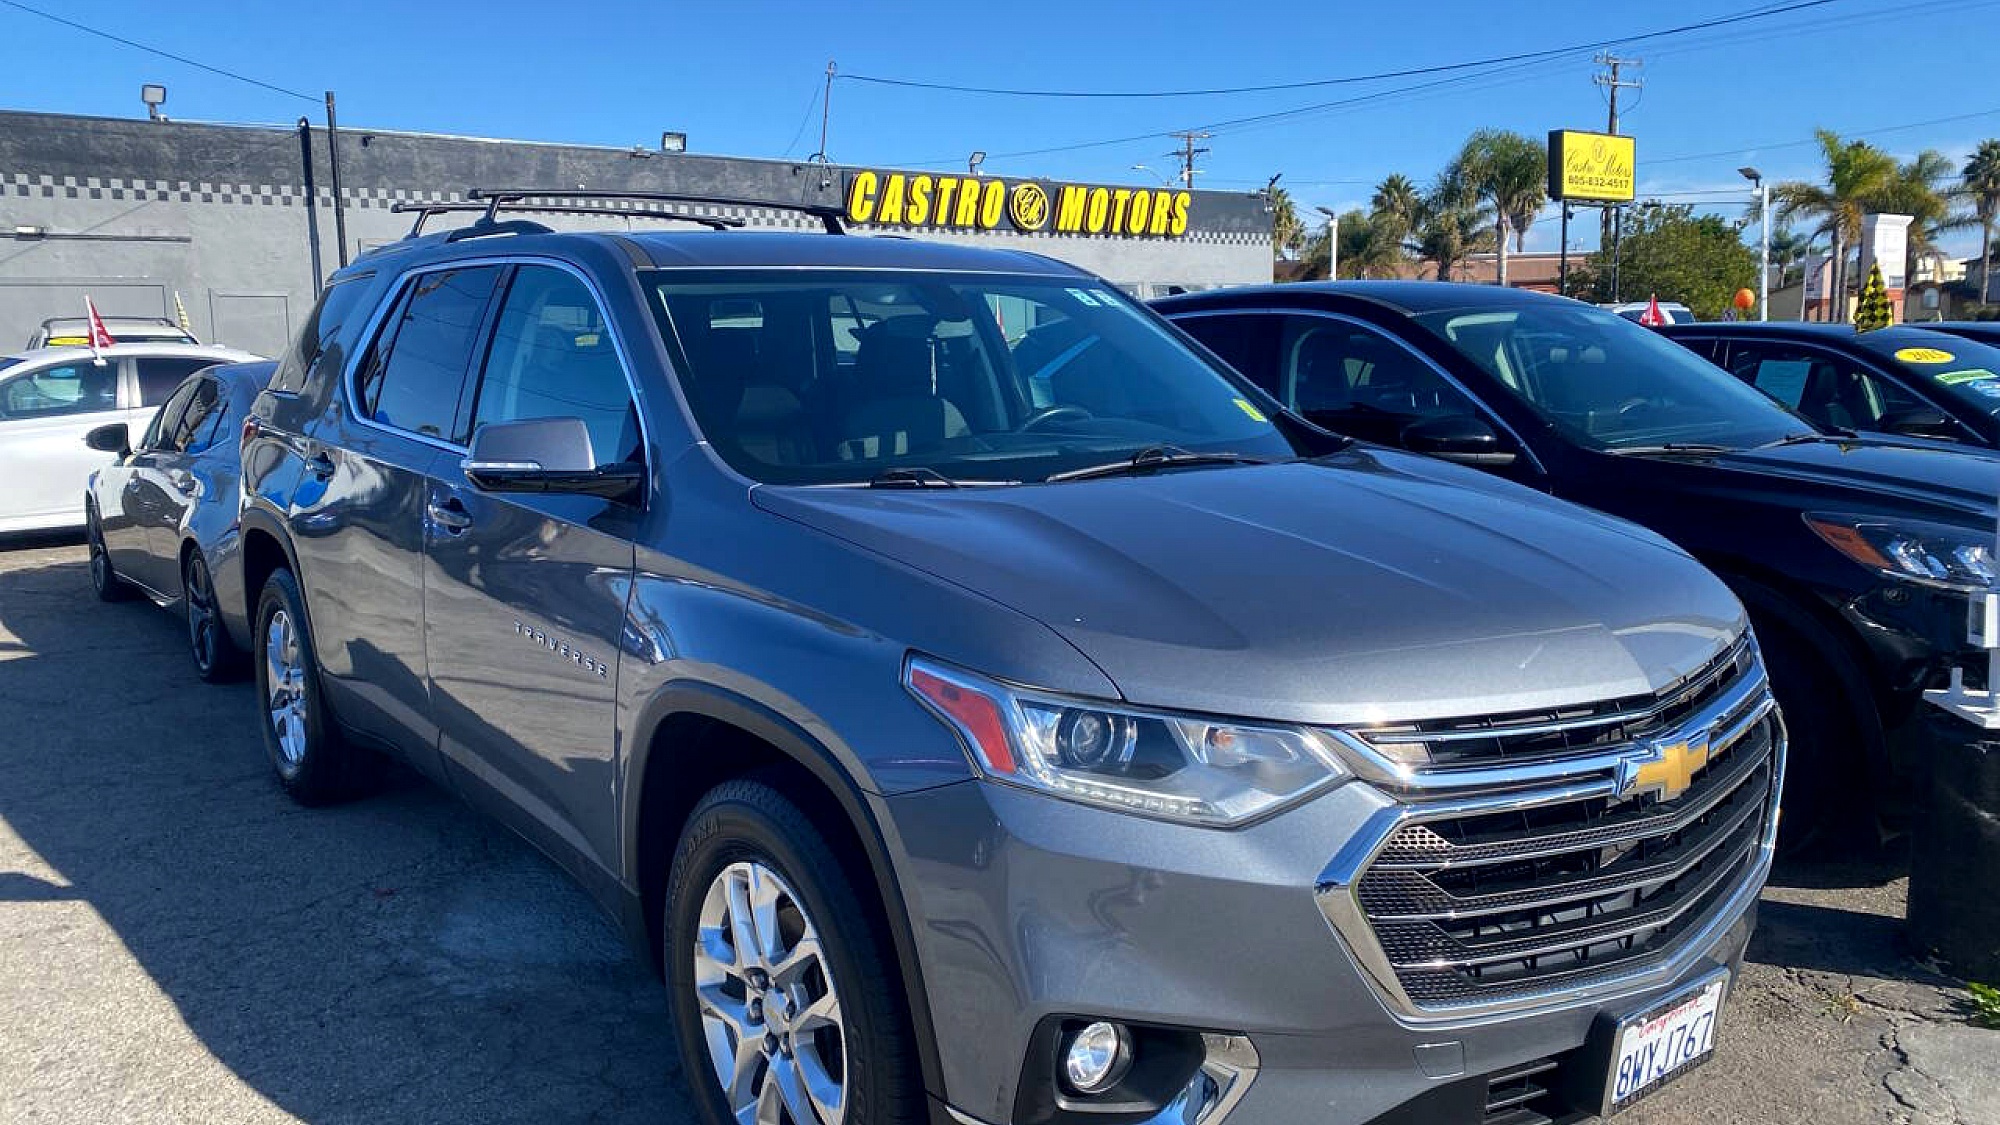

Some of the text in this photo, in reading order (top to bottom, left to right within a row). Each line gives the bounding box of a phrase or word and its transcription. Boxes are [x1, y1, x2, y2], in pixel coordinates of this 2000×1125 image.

[850, 171, 1191, 236] CASTRO MOTORS
[513, 619, 607, 678] TRAVERSE
[1616, 1009, 1714, 1097] 8WYJ767
